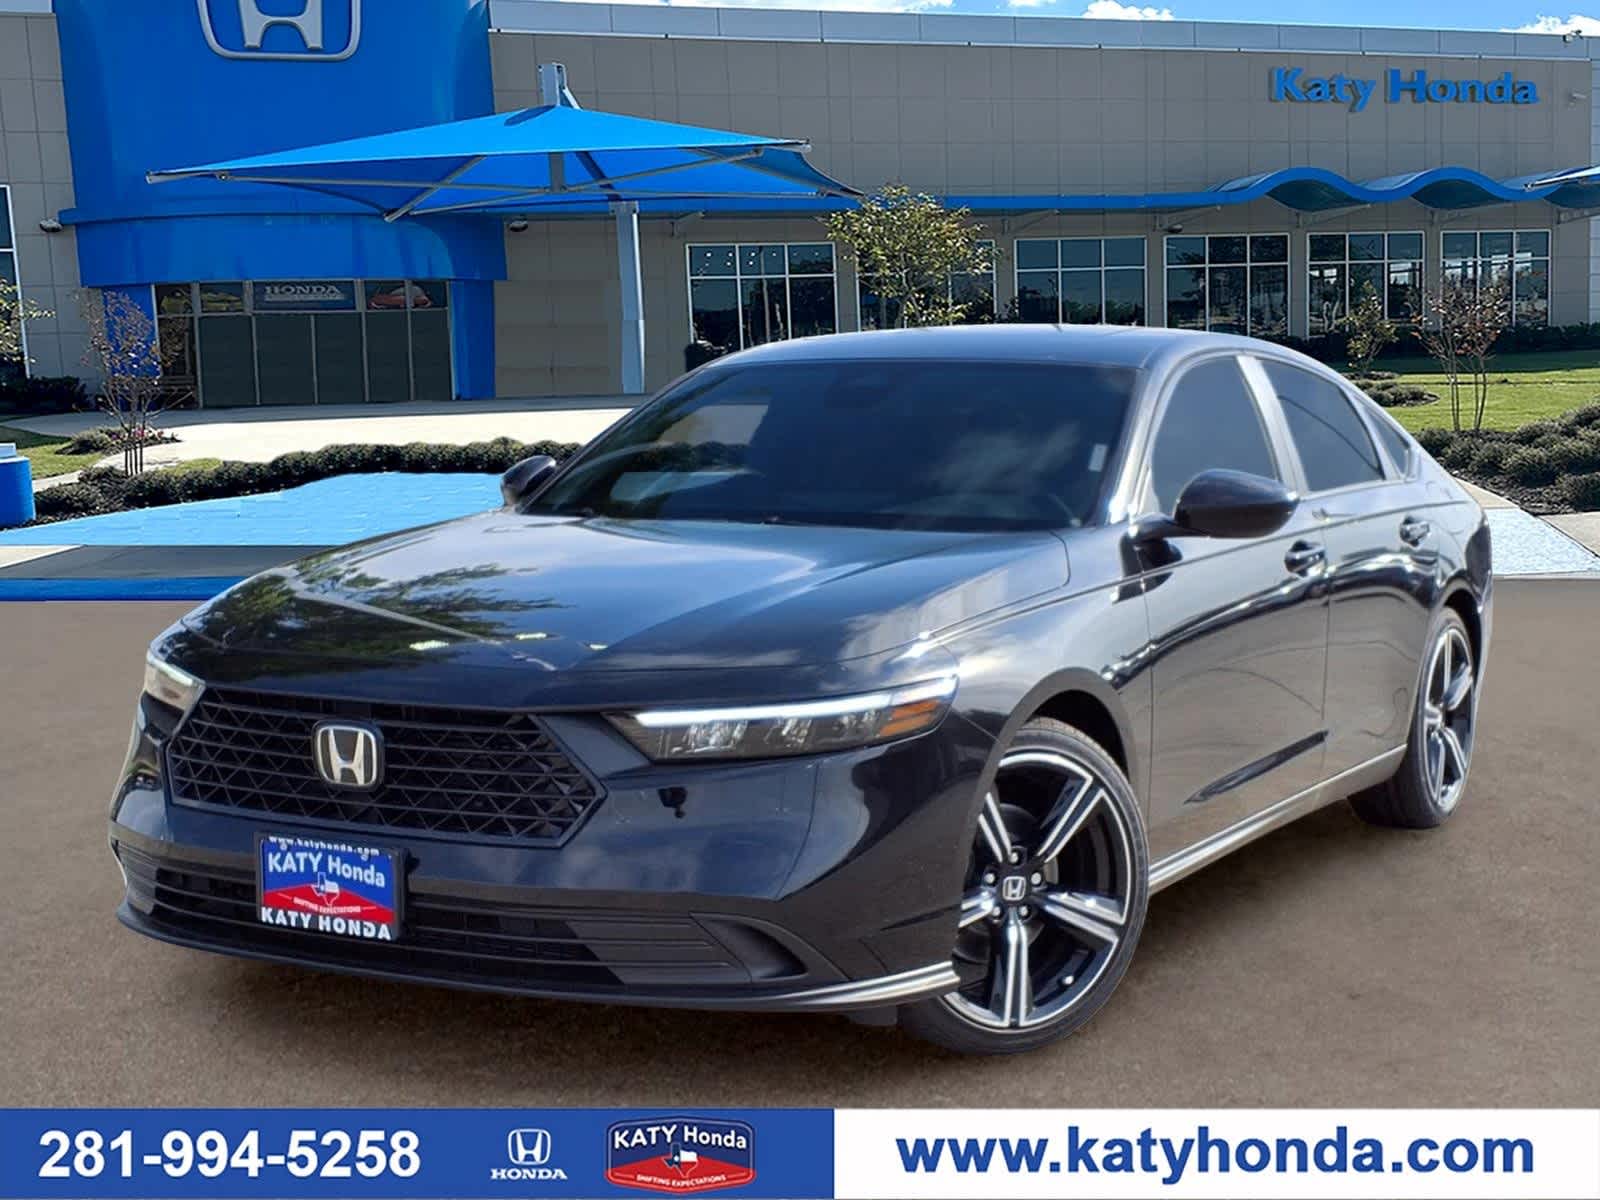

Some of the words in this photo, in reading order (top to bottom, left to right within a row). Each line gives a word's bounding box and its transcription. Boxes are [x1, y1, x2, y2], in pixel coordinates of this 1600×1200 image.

[1270, 67, 1376, 112] Katy
[1385, 68, 1539, 104] Honda
[264, 284, 342, 295] HONDA
[268, 852, 323, 873] KATY
[328, 855, 385, 888] Honda
[261, 906, 312, 929] KATY
[318, 914, 391, 941] HONDA
